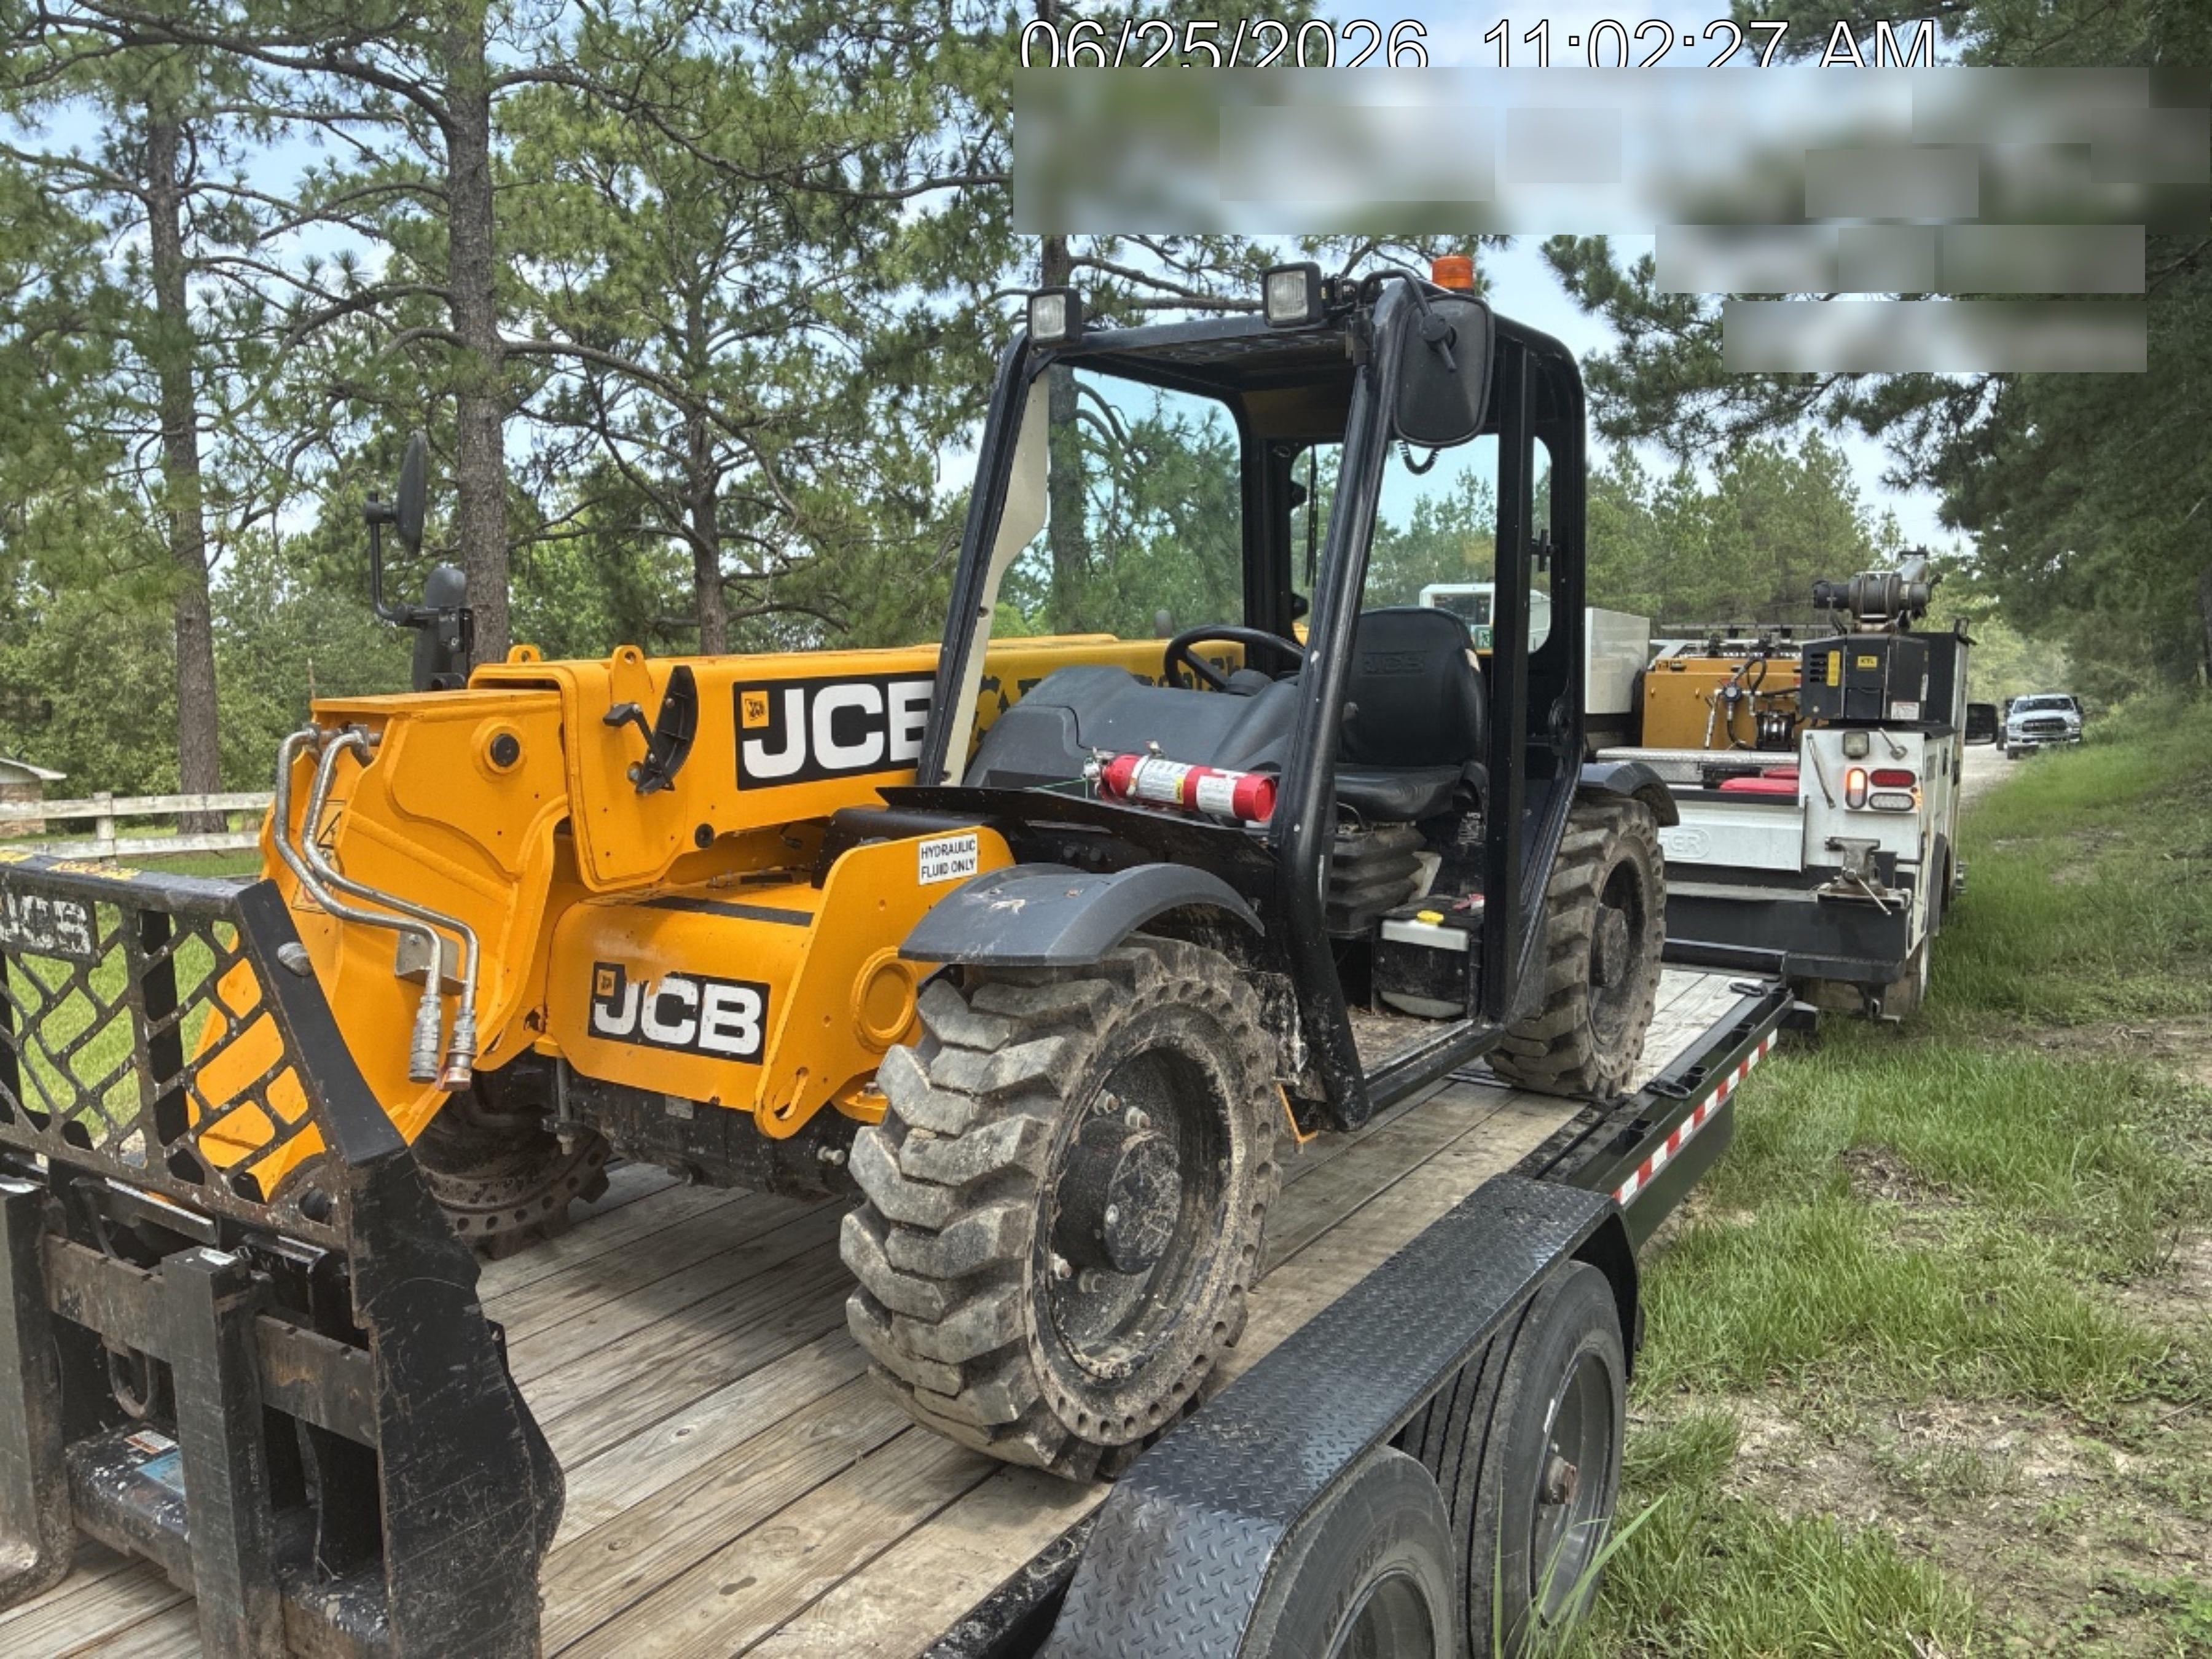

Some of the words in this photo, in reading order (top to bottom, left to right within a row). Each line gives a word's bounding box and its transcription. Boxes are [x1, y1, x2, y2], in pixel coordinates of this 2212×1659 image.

[921, 838, 976, 860] HYDRAULIC
[922, 862, 949, 879] FLUID
[951, 858, 975, 873] ONLY
[594, 977, 763, 1055] JCB
